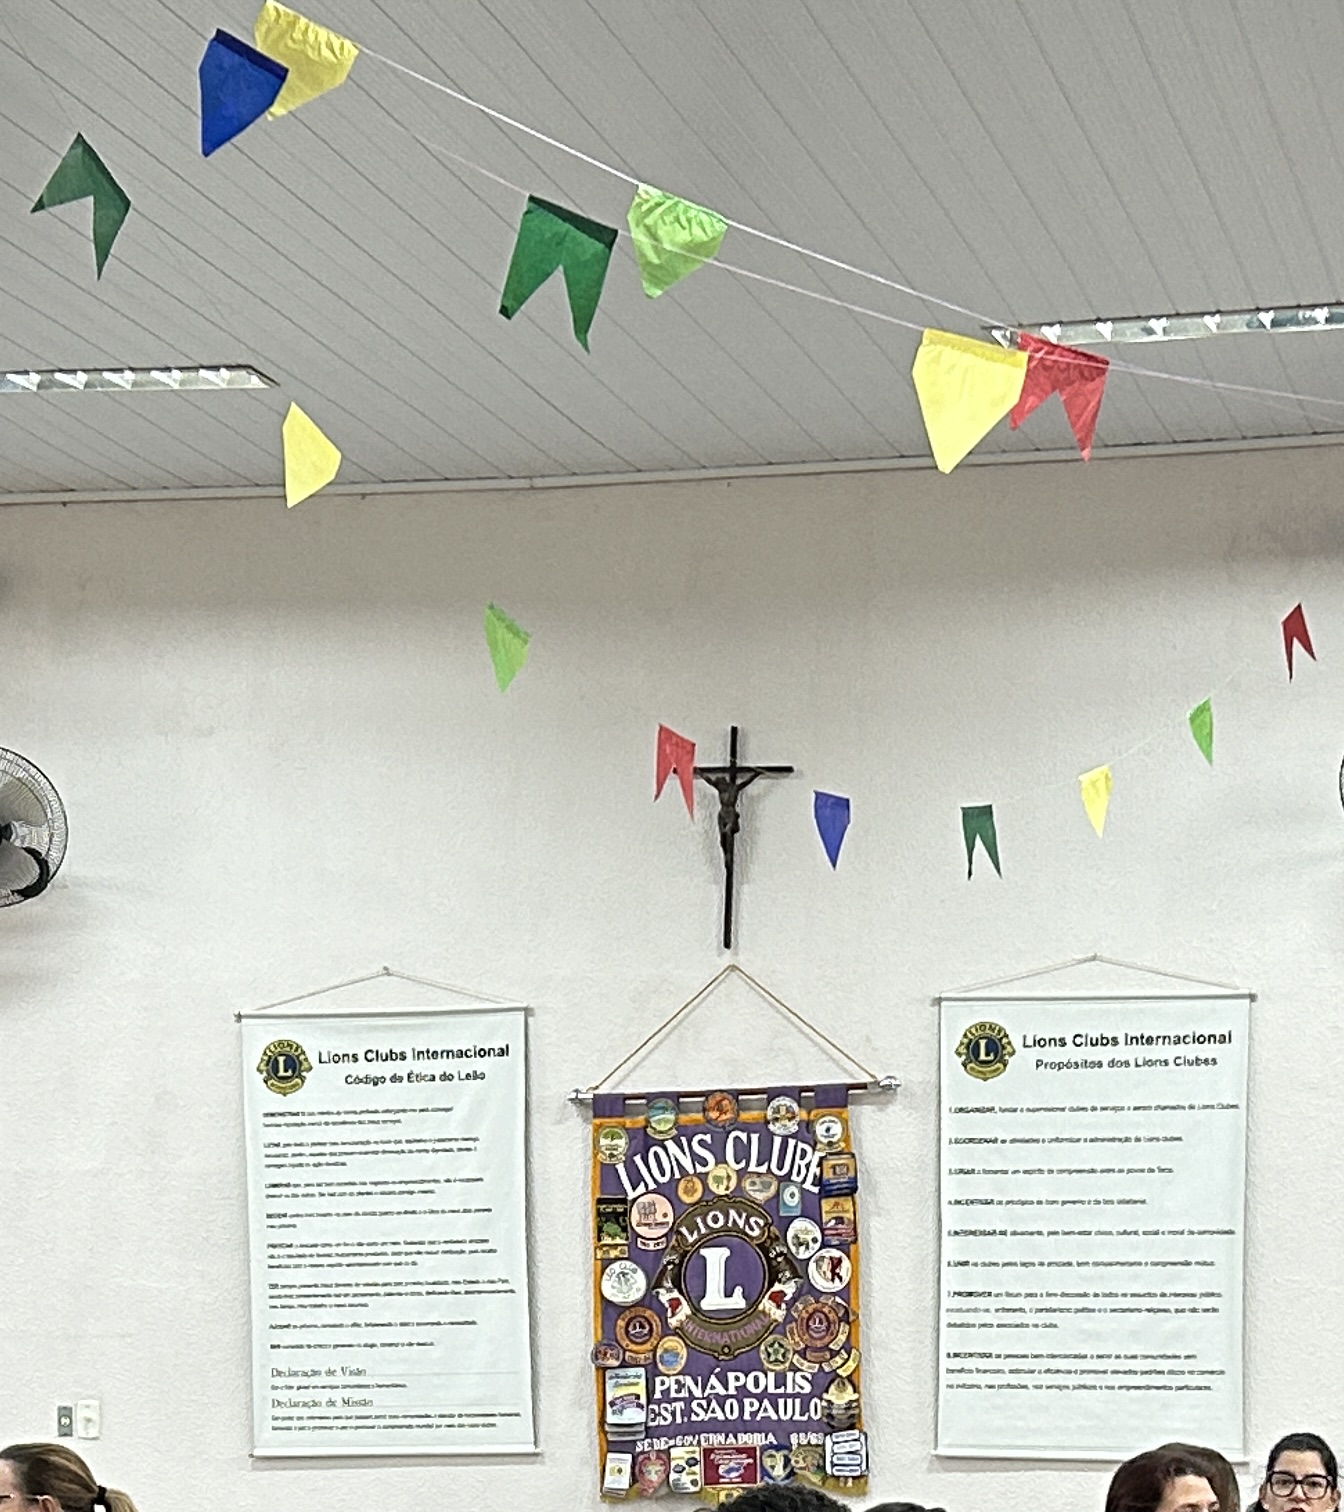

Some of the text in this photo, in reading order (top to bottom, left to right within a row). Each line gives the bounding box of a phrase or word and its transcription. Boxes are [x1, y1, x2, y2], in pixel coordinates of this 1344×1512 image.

[1022, 1030, 1232, 1048] Lions Clubs Internacional
[318, 1043, 509, 1064] Lions Clubs Internacional
[978, 1040, 994, 1061] L
[277, 1056, 293, 1077] L
[1035, 1055, 1218, 1071] Propósitos dos Lions Clubes
[439, 1071, 454, 1082] do
[615, 1130, 826, 1201] LIONS CLUBE
[678, 1208, 764, 1243] LIONS
[699, 1247, 746, 1310] L
[653, 1367, 812, 1399] PENÁPOLIS
[646, 1401, 688, 1427] EST.
[743, 1397, 822, 1421] PAULO
